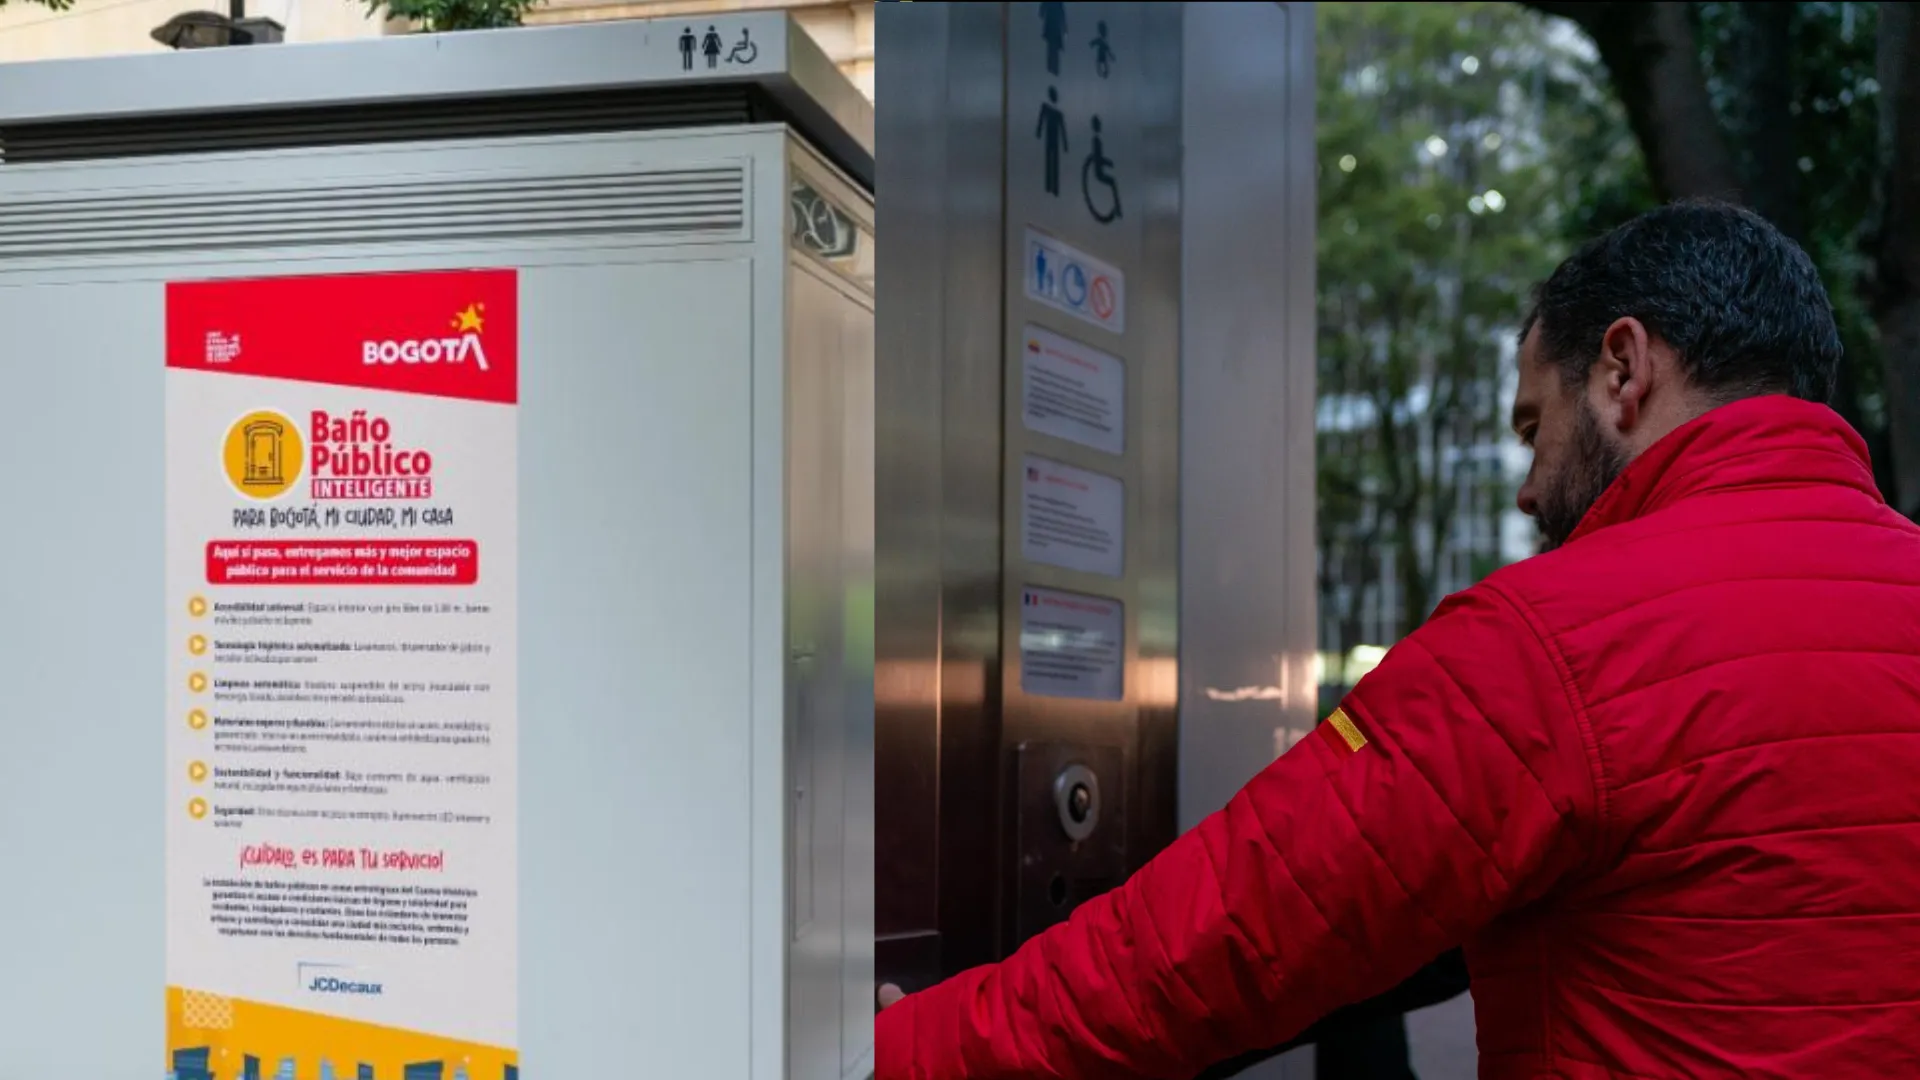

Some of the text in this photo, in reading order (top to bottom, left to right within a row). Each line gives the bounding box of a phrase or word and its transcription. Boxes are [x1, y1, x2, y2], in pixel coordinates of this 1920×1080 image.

[311, 411, 390, 443] Baño
[312, 445, 431, 475] Público
[314, 479, 430, 497] INTELIGENTE
[233, 508, 265, 528] PARA
[325, 507, 339, 527] MI
[345, 507, 397, 529] CIUDAD,
[402, 506, 417, 527] MI
[214, 545, 240, 562] Aquí
[285, 545, 352, 560] entregamos
[354, 545, 377, 558] más
[379, 548, 387, 560] y
[389, 545, 422, 561] mejor
[425, 545, 471, 559] espacio
[226, 563, 457, 579] público para el servicio de la comunidad
[308, 976, 383, 994] JCDecaux
